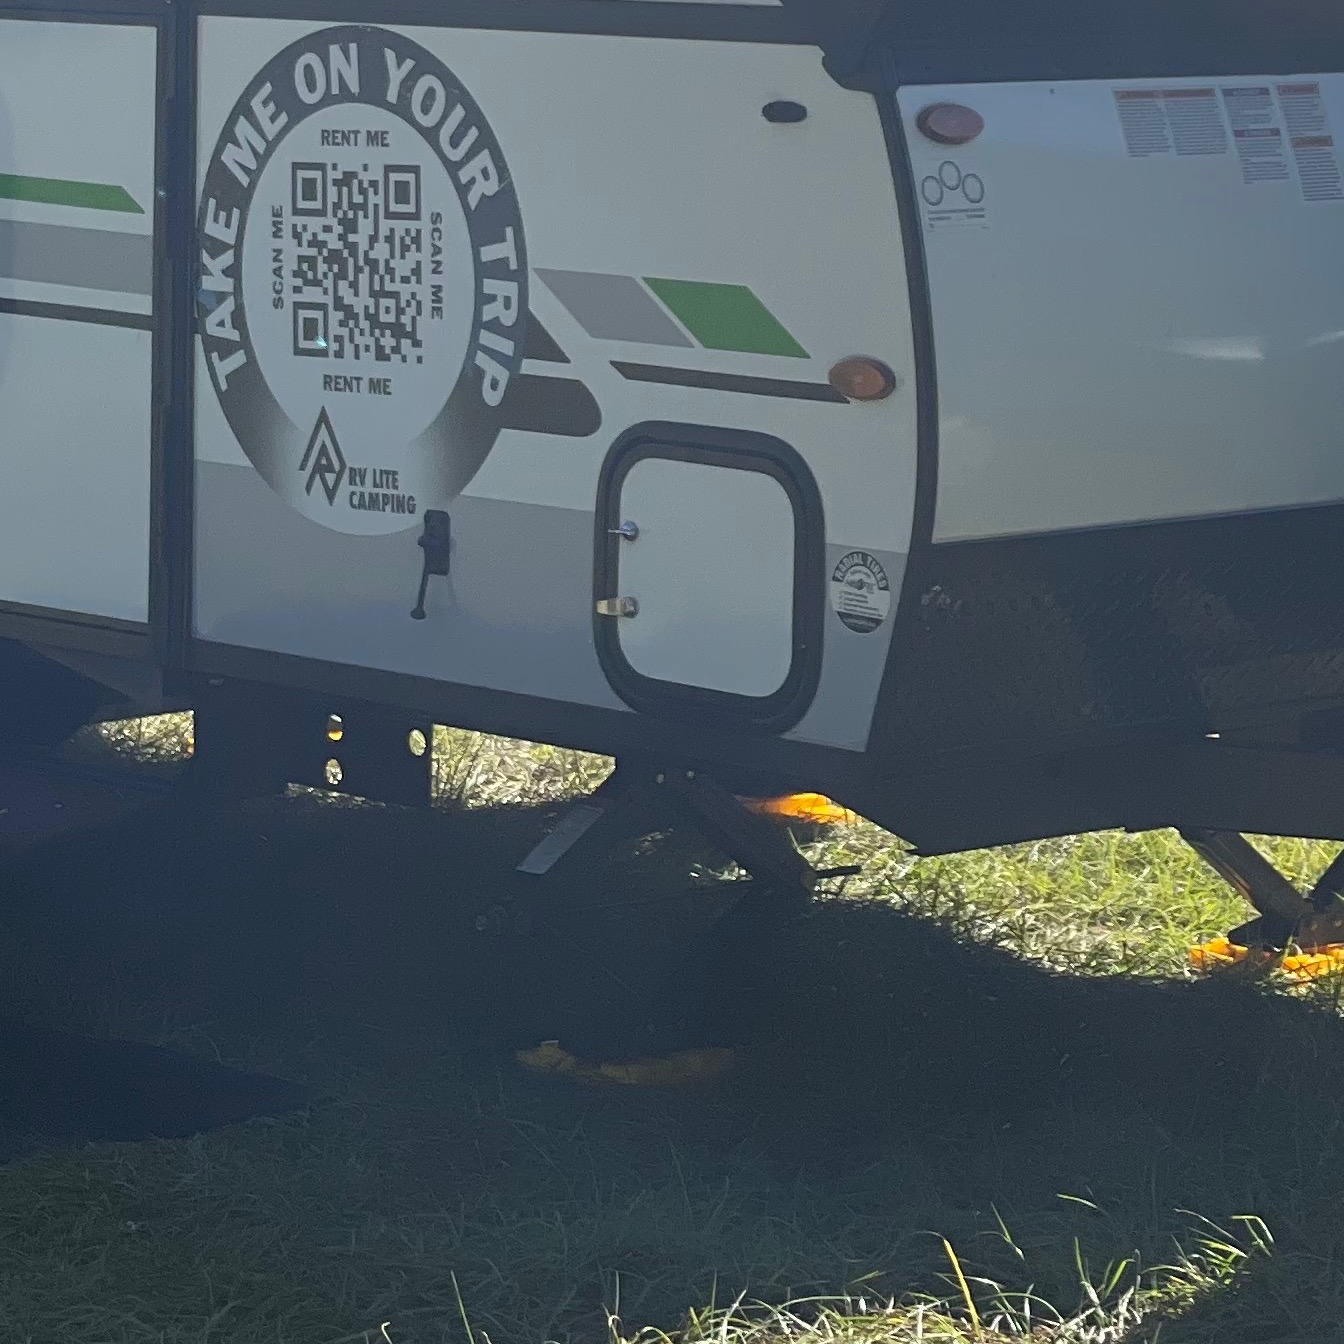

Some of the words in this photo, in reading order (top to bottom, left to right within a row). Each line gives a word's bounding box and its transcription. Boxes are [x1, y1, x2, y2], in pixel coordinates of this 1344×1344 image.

[294, 42, 361, 105] ON
[221, 81, 288, 188] ME
[320, 129, 362, 148] RENT
[366, 130, 391, 149] ME
[384, 47, 503, 211] YOUR
[271, 205, 284, 239] ME
[430, 211, 443, 276] SCAN
[201, 197, 248, 392] TAKE
[272, 248, 285, 310] SCAN
[430, 282, 443, 320] ME
[474, 226, 519, 407] TRIP
[323, 374, 364, 394] RENT
[367, 377, 393, 397] ME
[348, 466, 367, 488] RV
[372, 468, 400, 491] LITE
[348, 491, 417, 516] CAMPING
